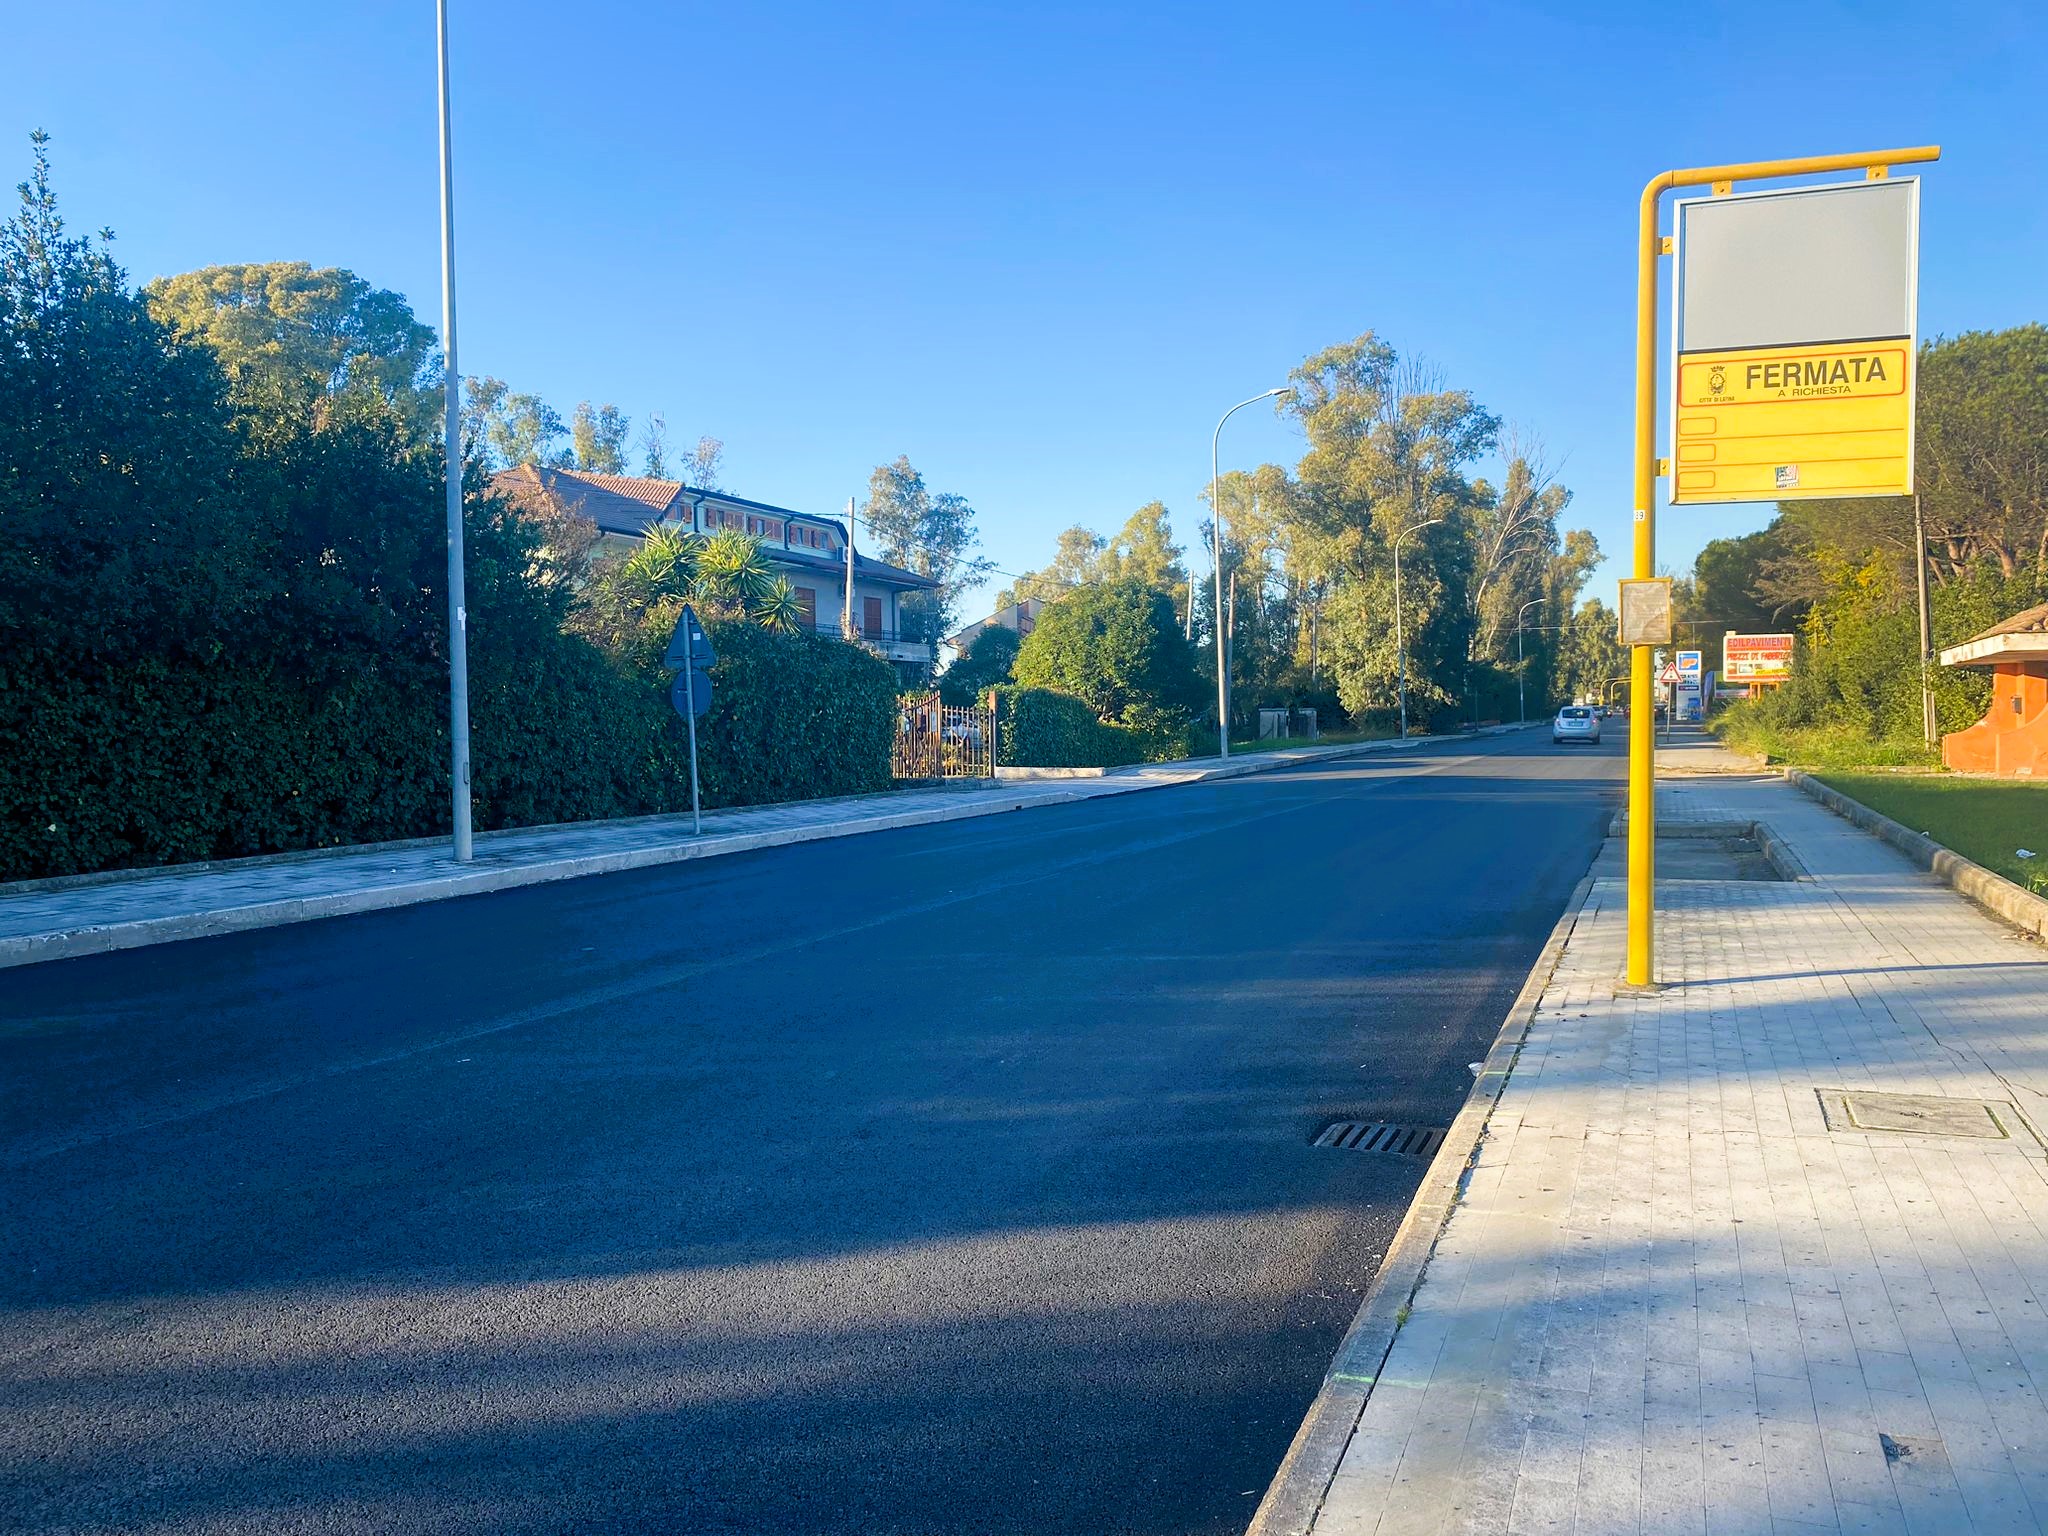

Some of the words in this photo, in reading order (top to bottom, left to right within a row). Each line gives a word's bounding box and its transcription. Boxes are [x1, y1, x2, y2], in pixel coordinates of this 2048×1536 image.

[1746, 357, 1887, 390] FERMATA
[1778, 388, 1786, 397] A
[1792, 385, 1851, 397] RICHIESTA
